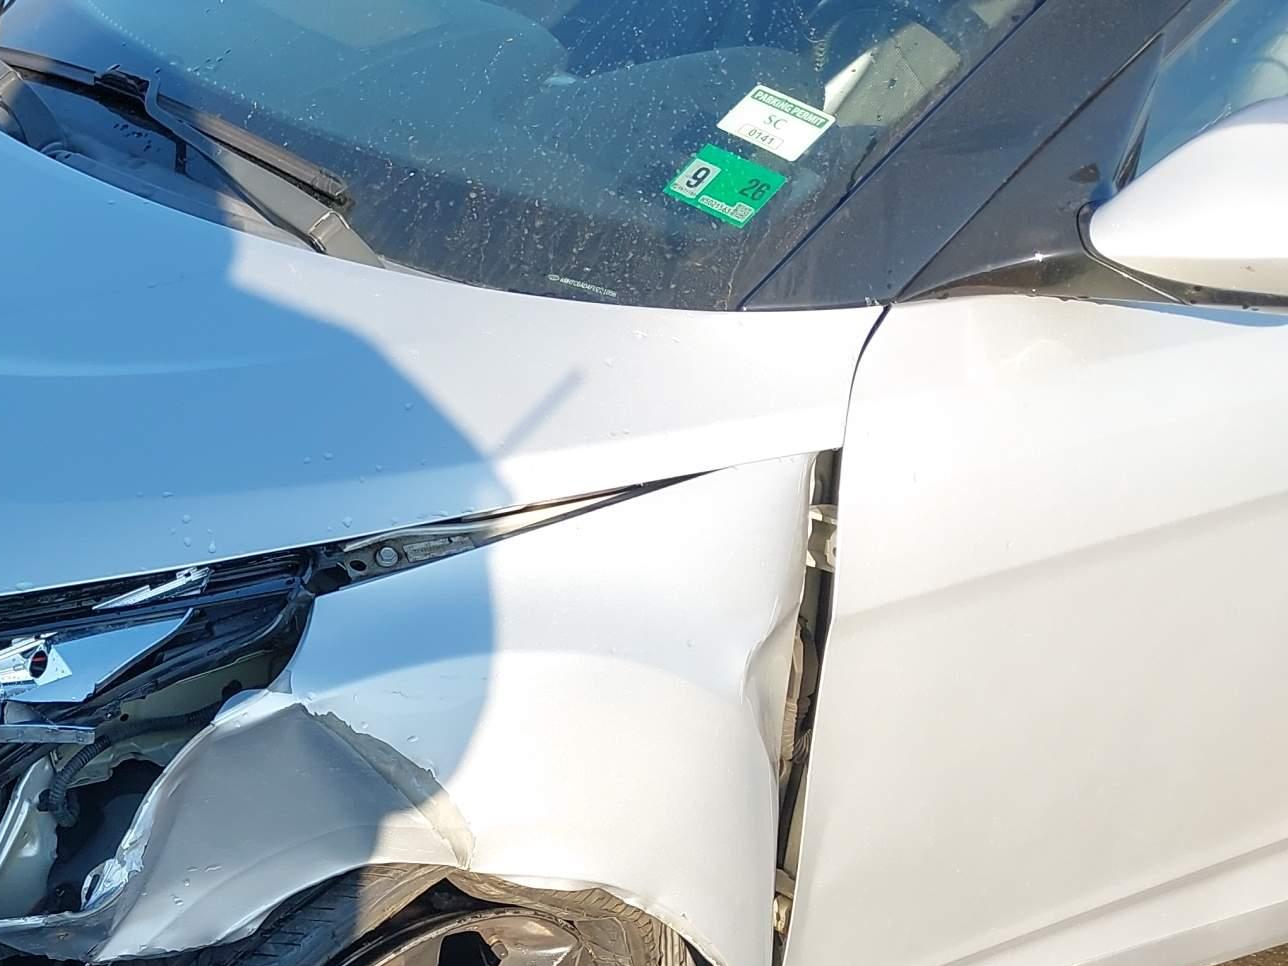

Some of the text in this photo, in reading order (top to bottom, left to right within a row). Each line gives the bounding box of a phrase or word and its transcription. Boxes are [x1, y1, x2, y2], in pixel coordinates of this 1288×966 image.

[754, 90, 827, 127] PARKING PERMIT
[764, 115, 789, 131] SC
[748, 129, 776, 146] 0141
[686, 167, 711, 188] 9
[739, 178, 771, 201] 26
